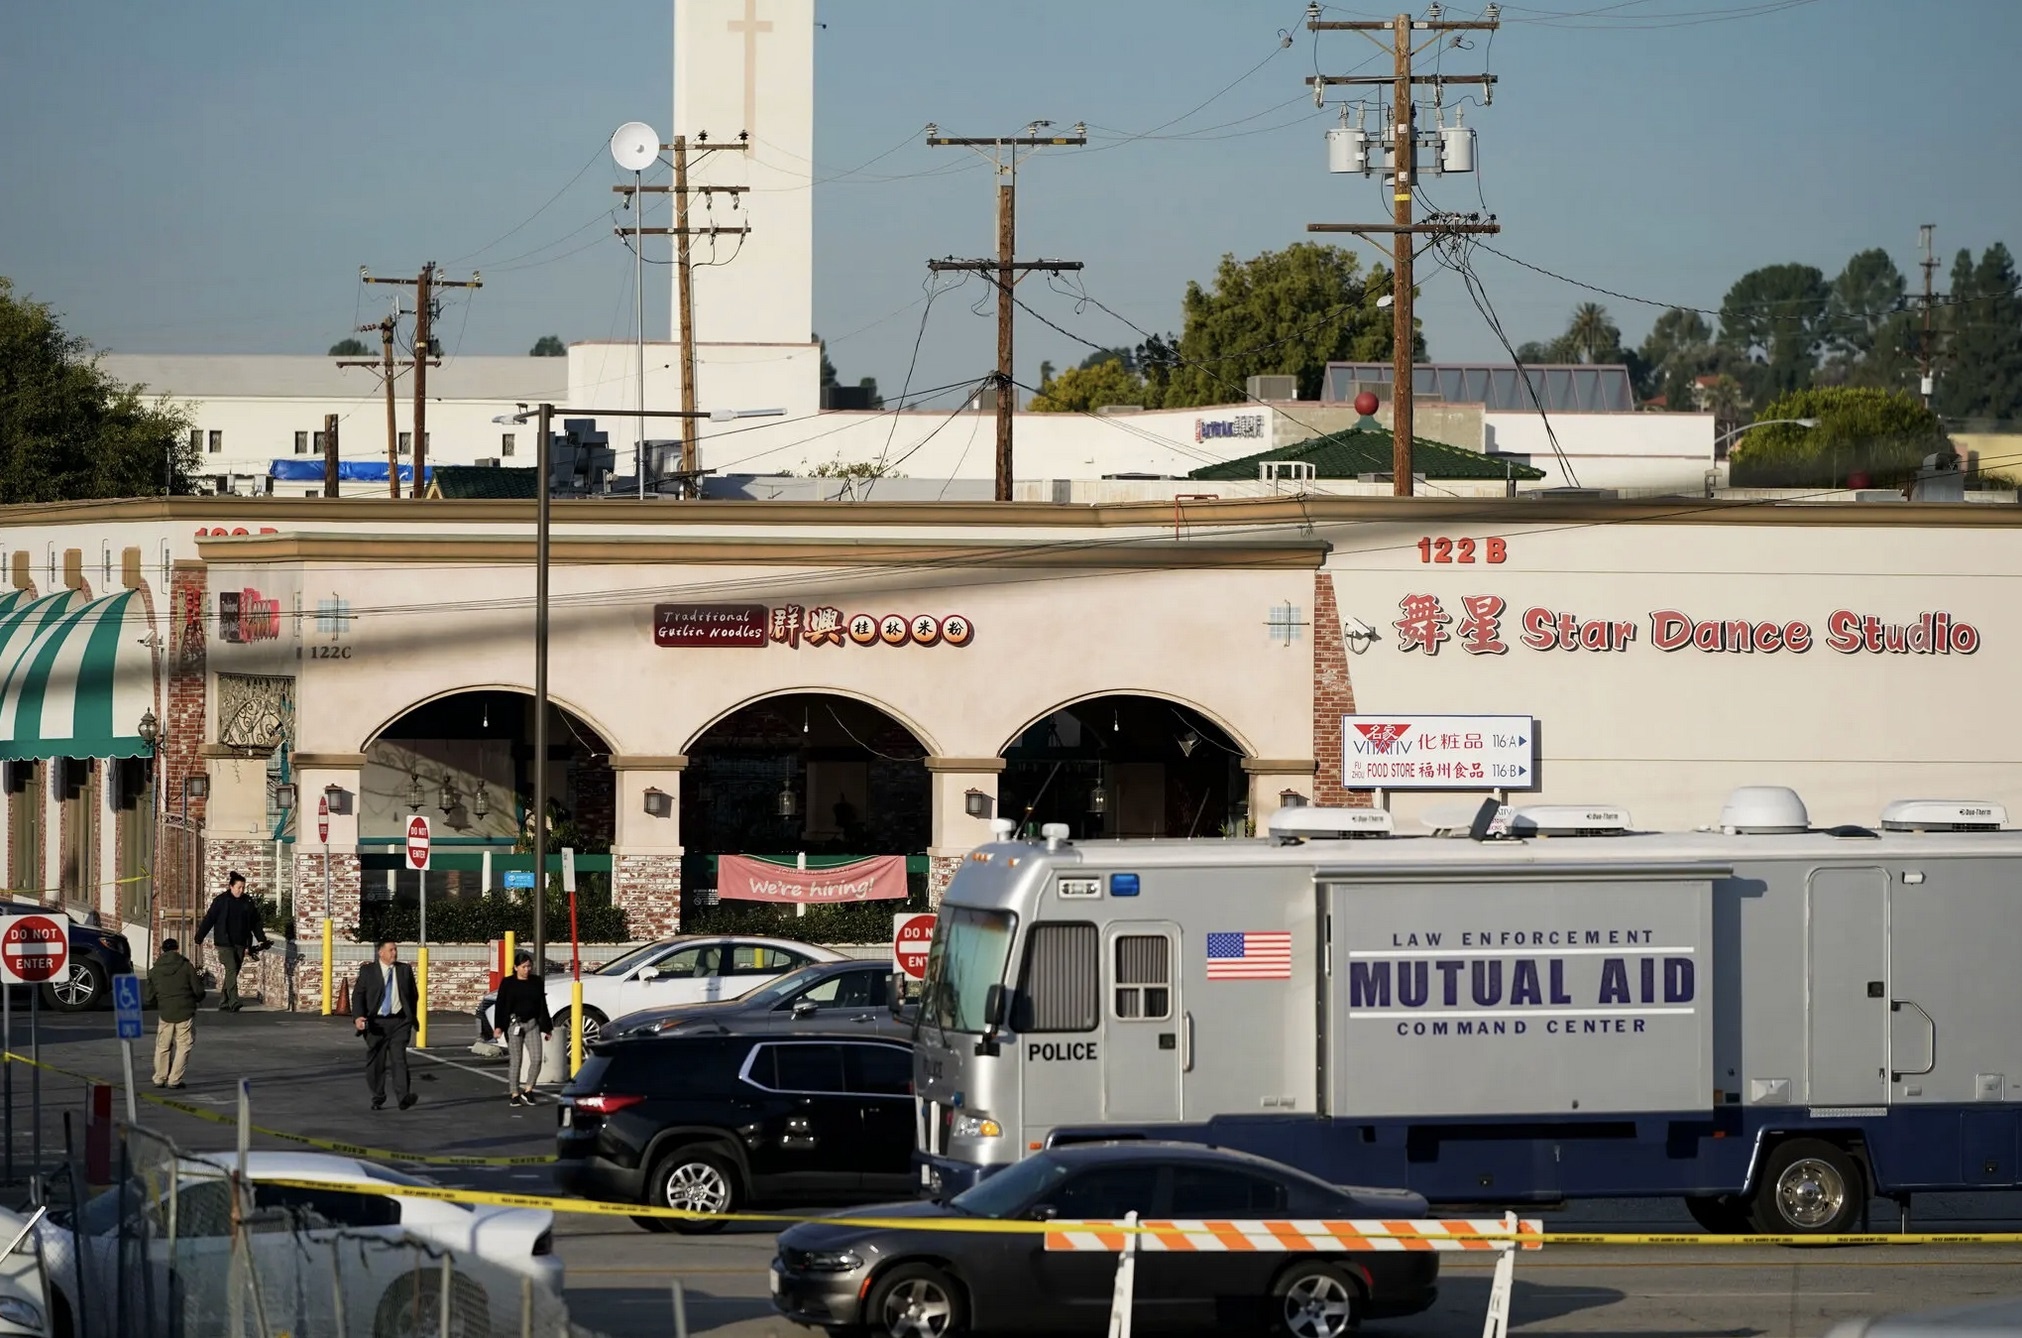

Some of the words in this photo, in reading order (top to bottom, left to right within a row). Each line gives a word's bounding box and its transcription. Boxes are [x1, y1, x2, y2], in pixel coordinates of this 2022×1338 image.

[1418, 537, 1476, 563] 122
[1486, 537, 1507, 564] B
[664, 609, 751, 622] Traditional
[658, 624, 704, 638] Guilin
[709, 624, 762, 638] Noodles
[1394, 593, 1511, 657] 舞星
[1520, 606, 1637, 652] Star
[1649, 609, 1813, 654] Dance
[1826, 608, 1981, 654] Studio
[311, 645, 352, 660] 122C
[1353, 740, 1413, 755] VITATIV
[1367, 763, 1389, 778] FOOD
[1391, 763, 1415, 778] STORE
[1418, 762, 1484, 779] 福州食品
[411, 826, 418, 836] DO
[419, 826, 427, 836] NOT
[412, 850, 425, 859] ENTER
[749, 878, 802, 896] We're
[809, 877, 875, 899] hiring!
[11, 928, 28, 940] DO
[32, 928, 57, 939] NOT
[904, 927, 921, 939] DO
[1393, 932, 1443, 947] LAW
[1462, 930, 1653, 946] ENFORCEMENT
[16, 958, 54, 969] ENTER
[1350, 959, 1572, 1007] MUTUAL
[1598, 957, 1695, 1004] AID
[1397, 1020, 1528, 1036] COMMAND
[1546, 1019, 1646, 1034] CENTER
[1028, 1042, 1098, 1061] POLICE
